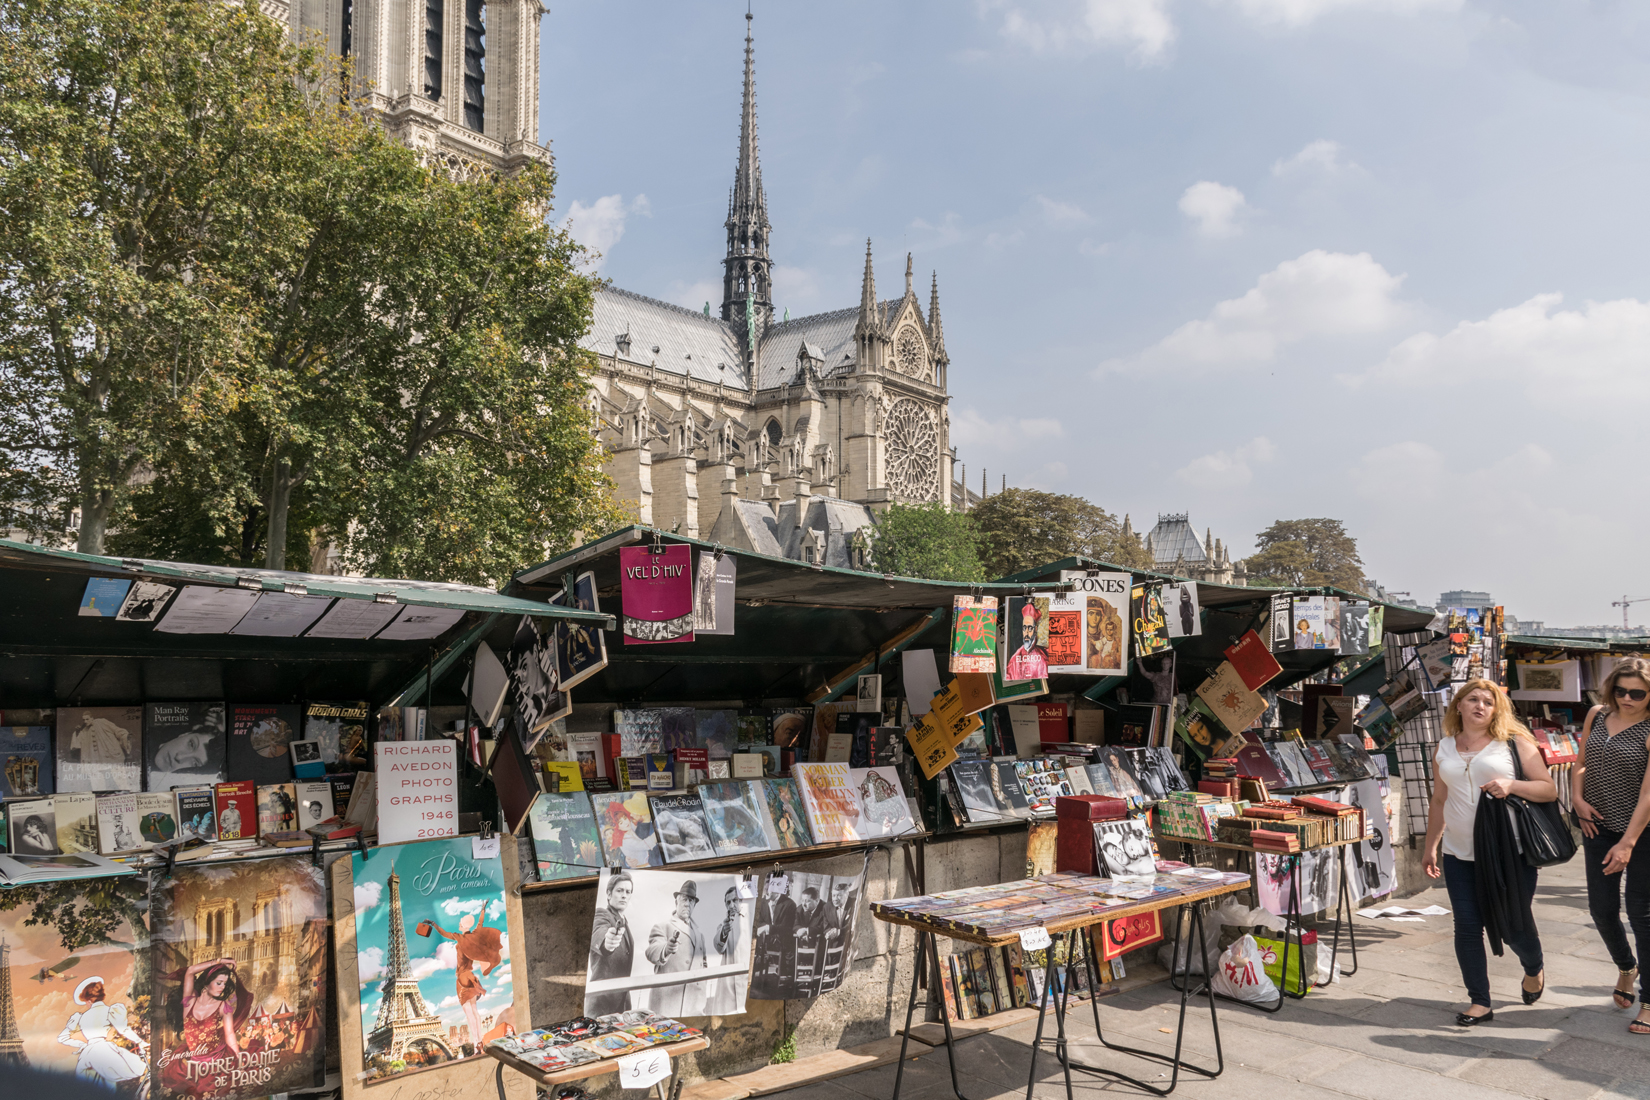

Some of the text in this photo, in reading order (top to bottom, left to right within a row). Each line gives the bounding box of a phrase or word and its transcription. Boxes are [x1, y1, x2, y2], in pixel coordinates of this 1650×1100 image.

[652, 556, 660, 564] LE
[1134, 614, 1164, 633] Chagall
[1016, 654, 1042, 663] EL GRECO
[1330, 700, 1352, 708] Avions
[154, 706, 189, 716] Man Ray
[307, 706, 369, 718] URBAN GIRLS
[1045, 708, 1063, 717] Soleil
[154, 714, 189, 722] Portraits
[384, 745, 452, 756] RICHARD
[62, 764, 74, 772] LA
[390, 762, 453, 772] AVEDON
[801, 764, 848, 776] NORMAN
[105, 770, 136, 780] D'ORSAY
[401, 777, 453, 788] PHOTO
[805, 776, 846, 788] MAILER
[807, 788, 856, 800] MARILYN
[390, 794, 453, 806] GRAPHS
[654, 798, 677, 808] Claudel
[682, 798, 702, 806] Rodin
[98, 806, 137, 816] CULTURE
[810, 800, 858, 812] MONROE
[420, 810, 454, 821] 1946
[566, 812, 590, 820] Rousseau
[814, 813, 842, 825] BERT
[221, 832, 230, 840] 10
[417, 827, 455, 838] 2004
[818, 825, 853, 838] STERN
[718, 838, 739, 848] DEGAS
[412, 850, 483, 897] Paris
[440, 885, 458, 894] mon
[156, 1042, 210, 1069] Esmeralda
[185, 1048, 281, 1084] NOTRE DAME
